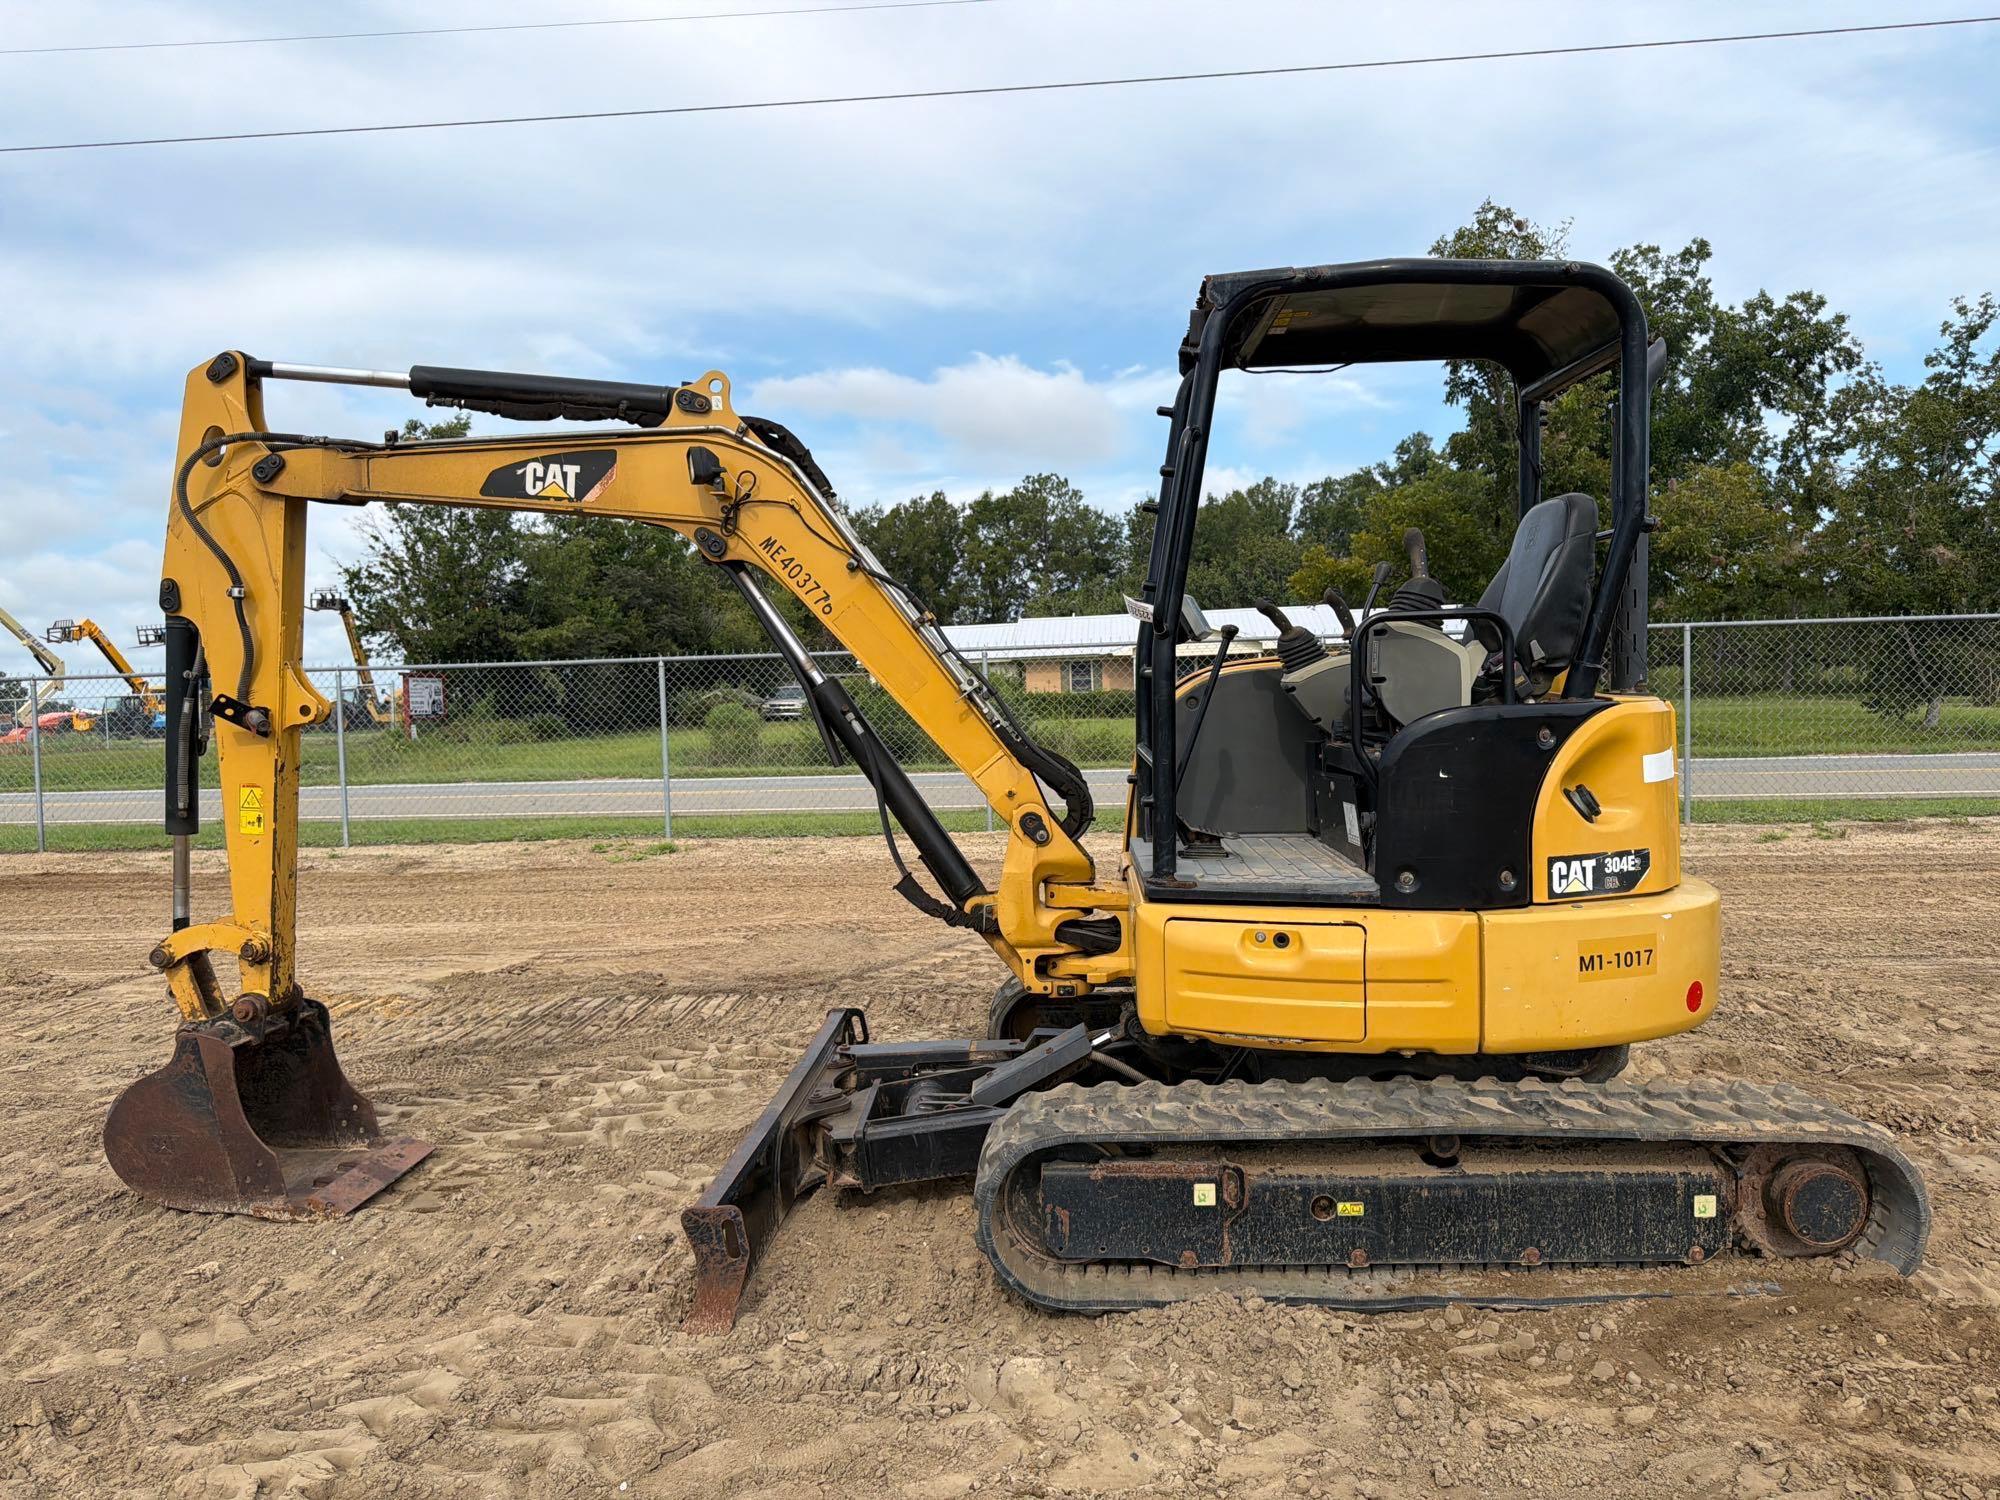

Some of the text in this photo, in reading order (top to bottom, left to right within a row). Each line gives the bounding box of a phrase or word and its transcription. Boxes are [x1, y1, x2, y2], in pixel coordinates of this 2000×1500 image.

[525, 461, 581, 499] CAT
[1551, 859, 1597, 894] CAT
[1579, 949, 1654, 972] M1-1017
